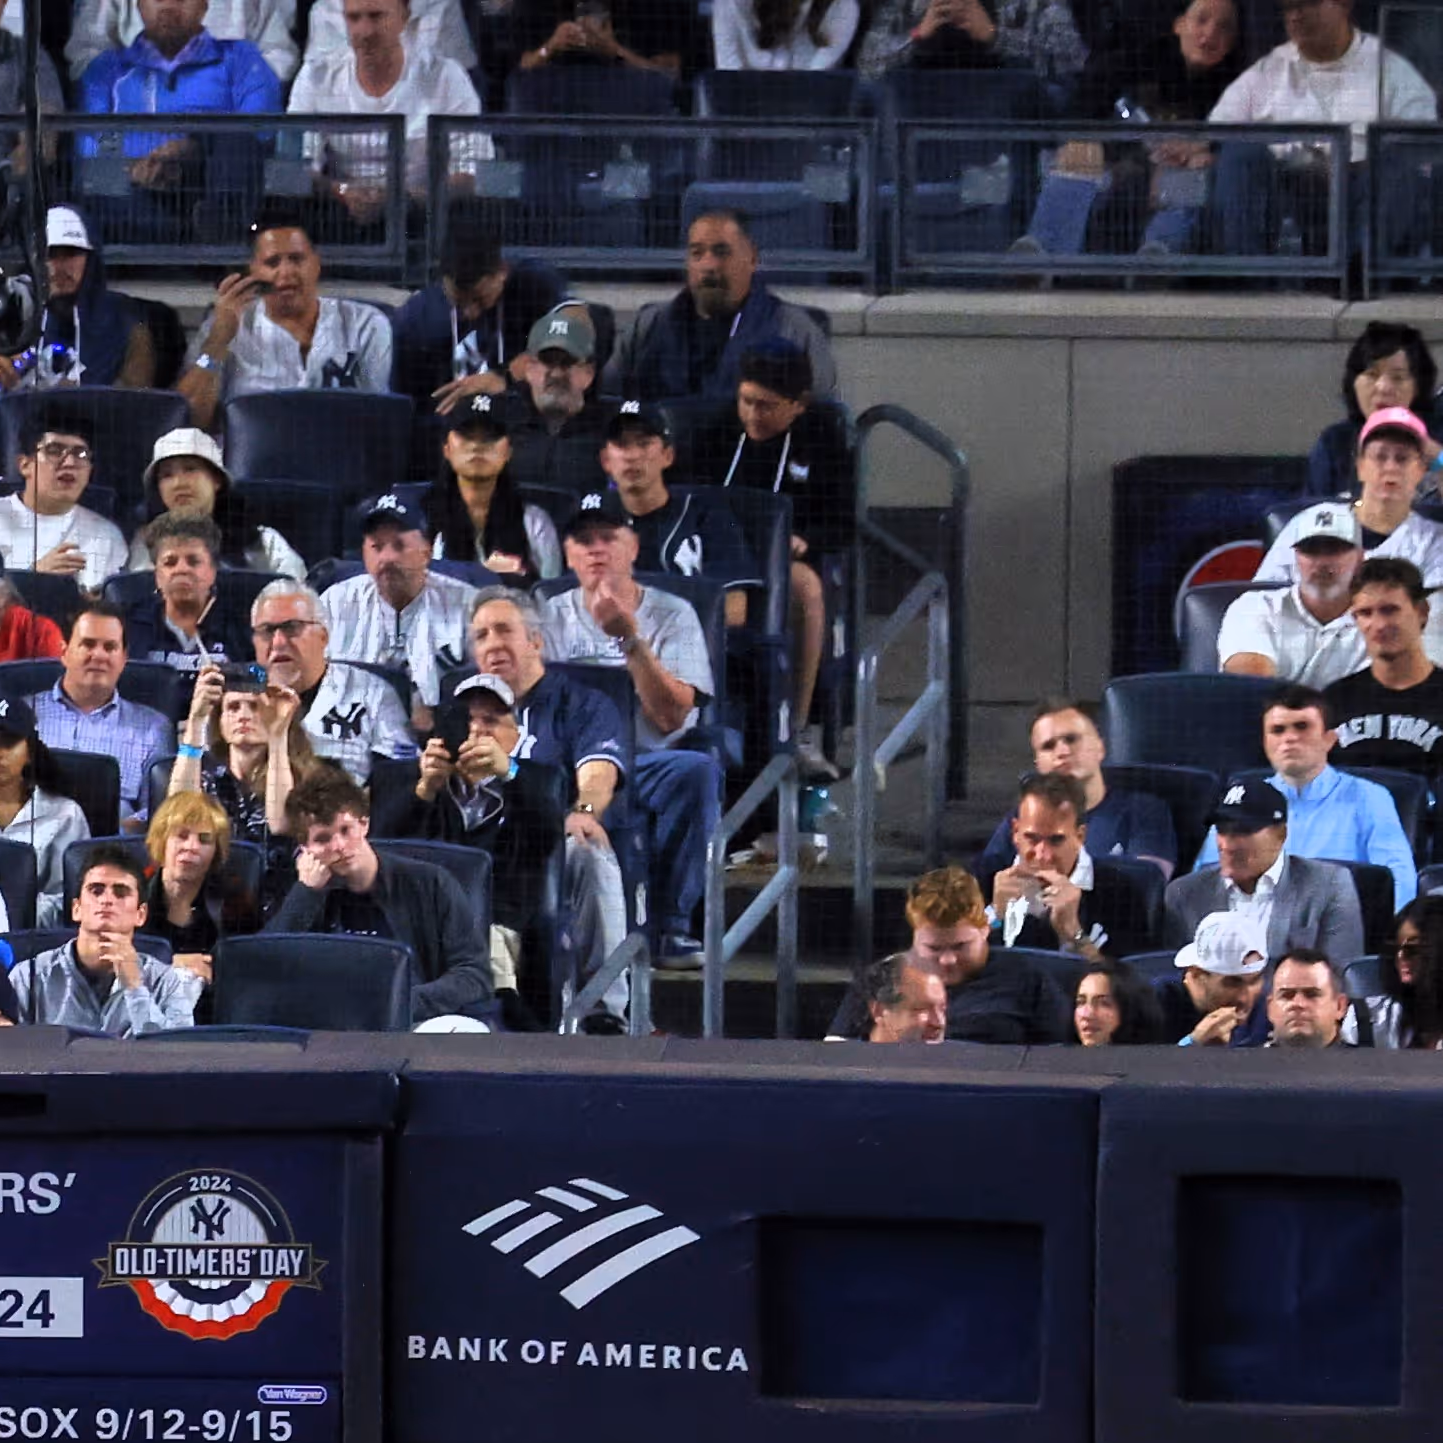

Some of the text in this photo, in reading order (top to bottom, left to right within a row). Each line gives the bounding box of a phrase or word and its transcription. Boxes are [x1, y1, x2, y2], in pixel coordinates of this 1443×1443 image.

[189, 1176, 231, 1193] 2024
[115, 1248, 304, 1276] OLD-TIMERS' DAY
[408, 1335, 749, 1372] BANK OF AMERICA
[95, 1407, 292, 1442] 9/12-9/15
